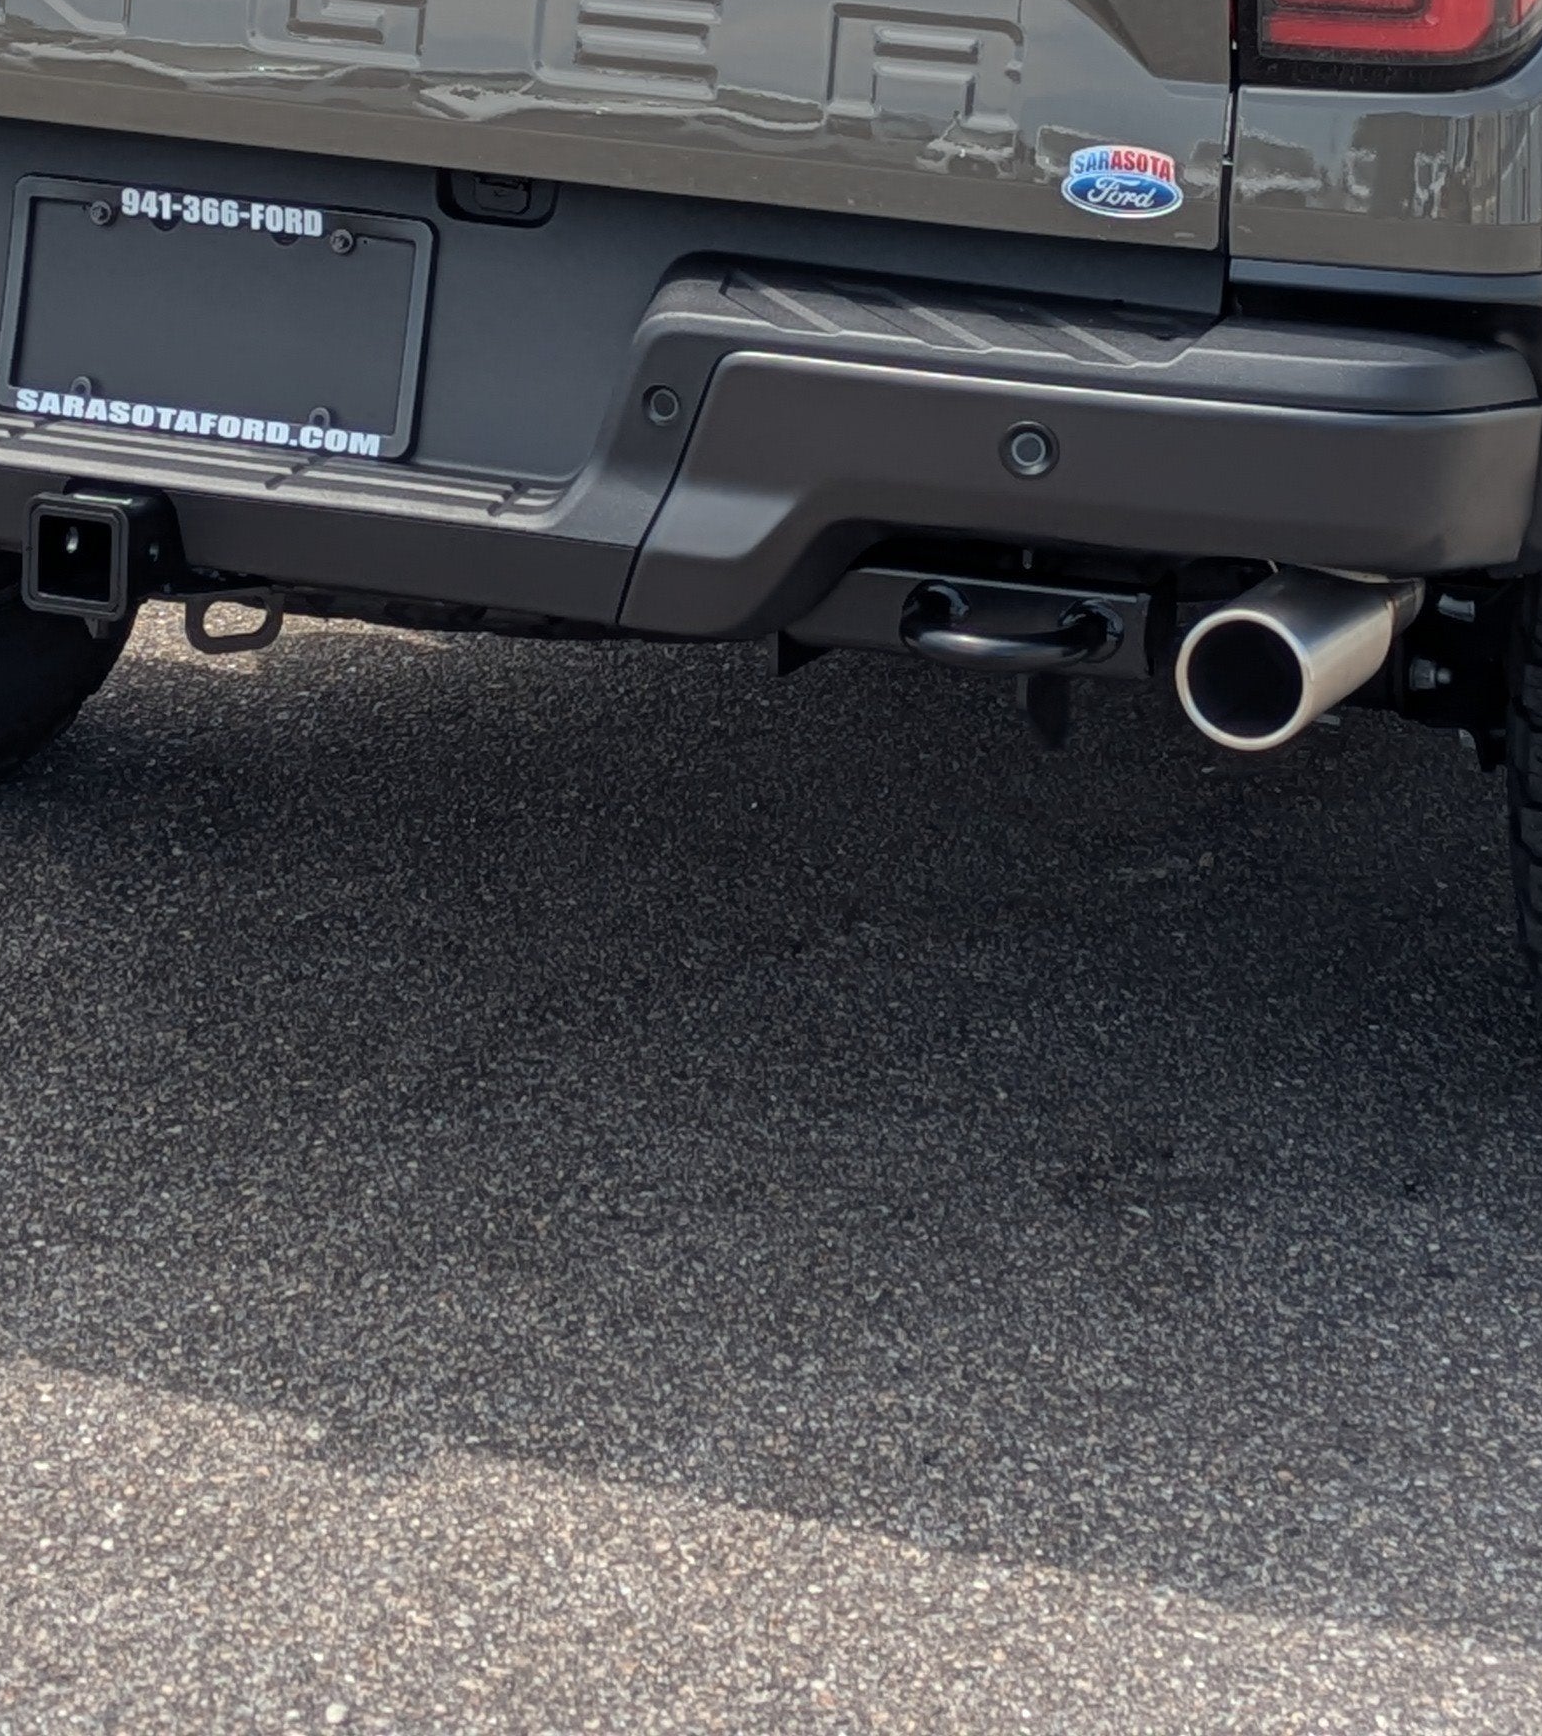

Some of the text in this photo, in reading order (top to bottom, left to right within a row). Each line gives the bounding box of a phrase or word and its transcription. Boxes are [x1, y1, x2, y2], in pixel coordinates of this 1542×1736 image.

[1074, 150, 1172, 182] SARASOTA
[120, 186, 324, 239] 941-366-FORD
[1086, 176, 1157, 209] Ford
[15, 387, 381, 458] SARASOTAFORD.COM
